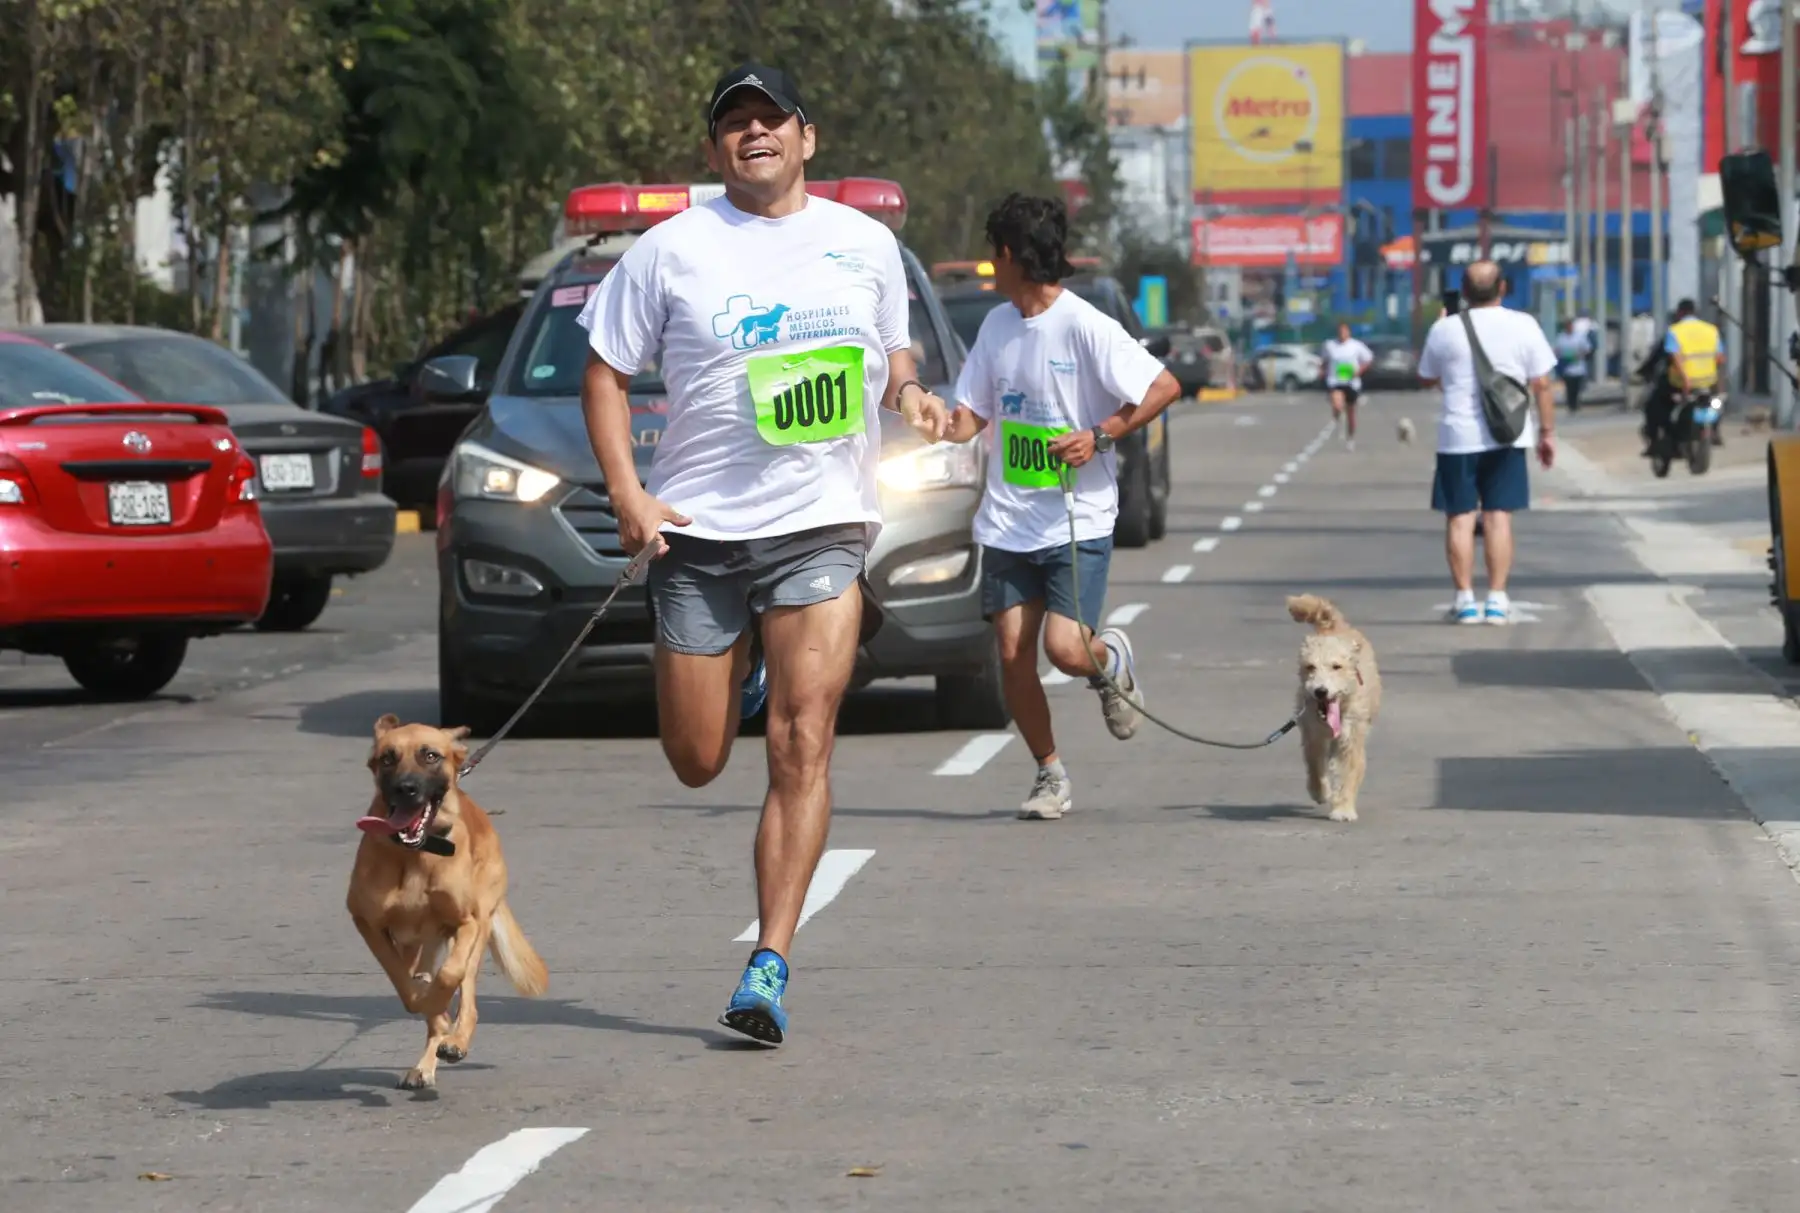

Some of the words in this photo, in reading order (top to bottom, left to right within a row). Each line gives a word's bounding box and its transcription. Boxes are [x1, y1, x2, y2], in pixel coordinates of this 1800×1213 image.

[1227, 96, 1312, 118] Metro
[787, 305, 850, 322] HOSPITALES
[788, 326, 860, 341] VETERINARIOS
[773, 369, 848, 431] 0001
